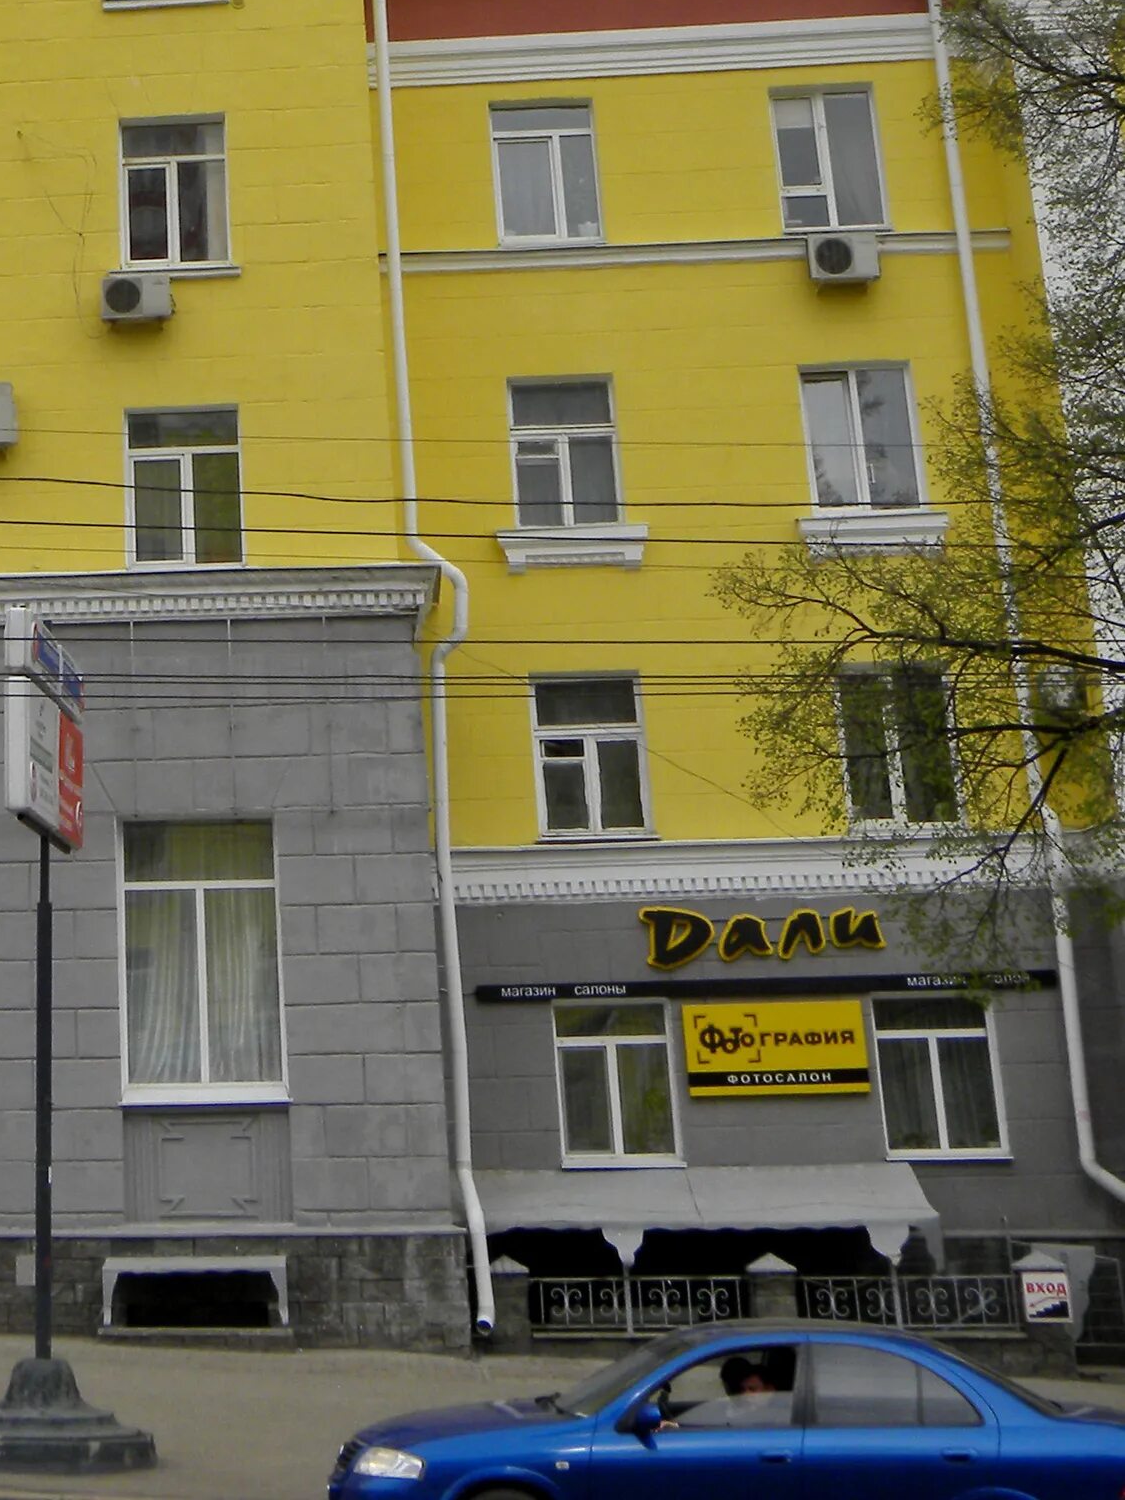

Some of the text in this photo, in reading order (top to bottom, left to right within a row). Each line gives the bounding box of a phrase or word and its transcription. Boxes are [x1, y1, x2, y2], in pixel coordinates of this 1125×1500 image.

[638, 906, 886, 971] Дали
[501, 984, 627, 997] магазин салоны
[727, 1072, 832, 1084] ФОТОСАЛОН
[1025, 1283, 1067, 1296] ВХОД
